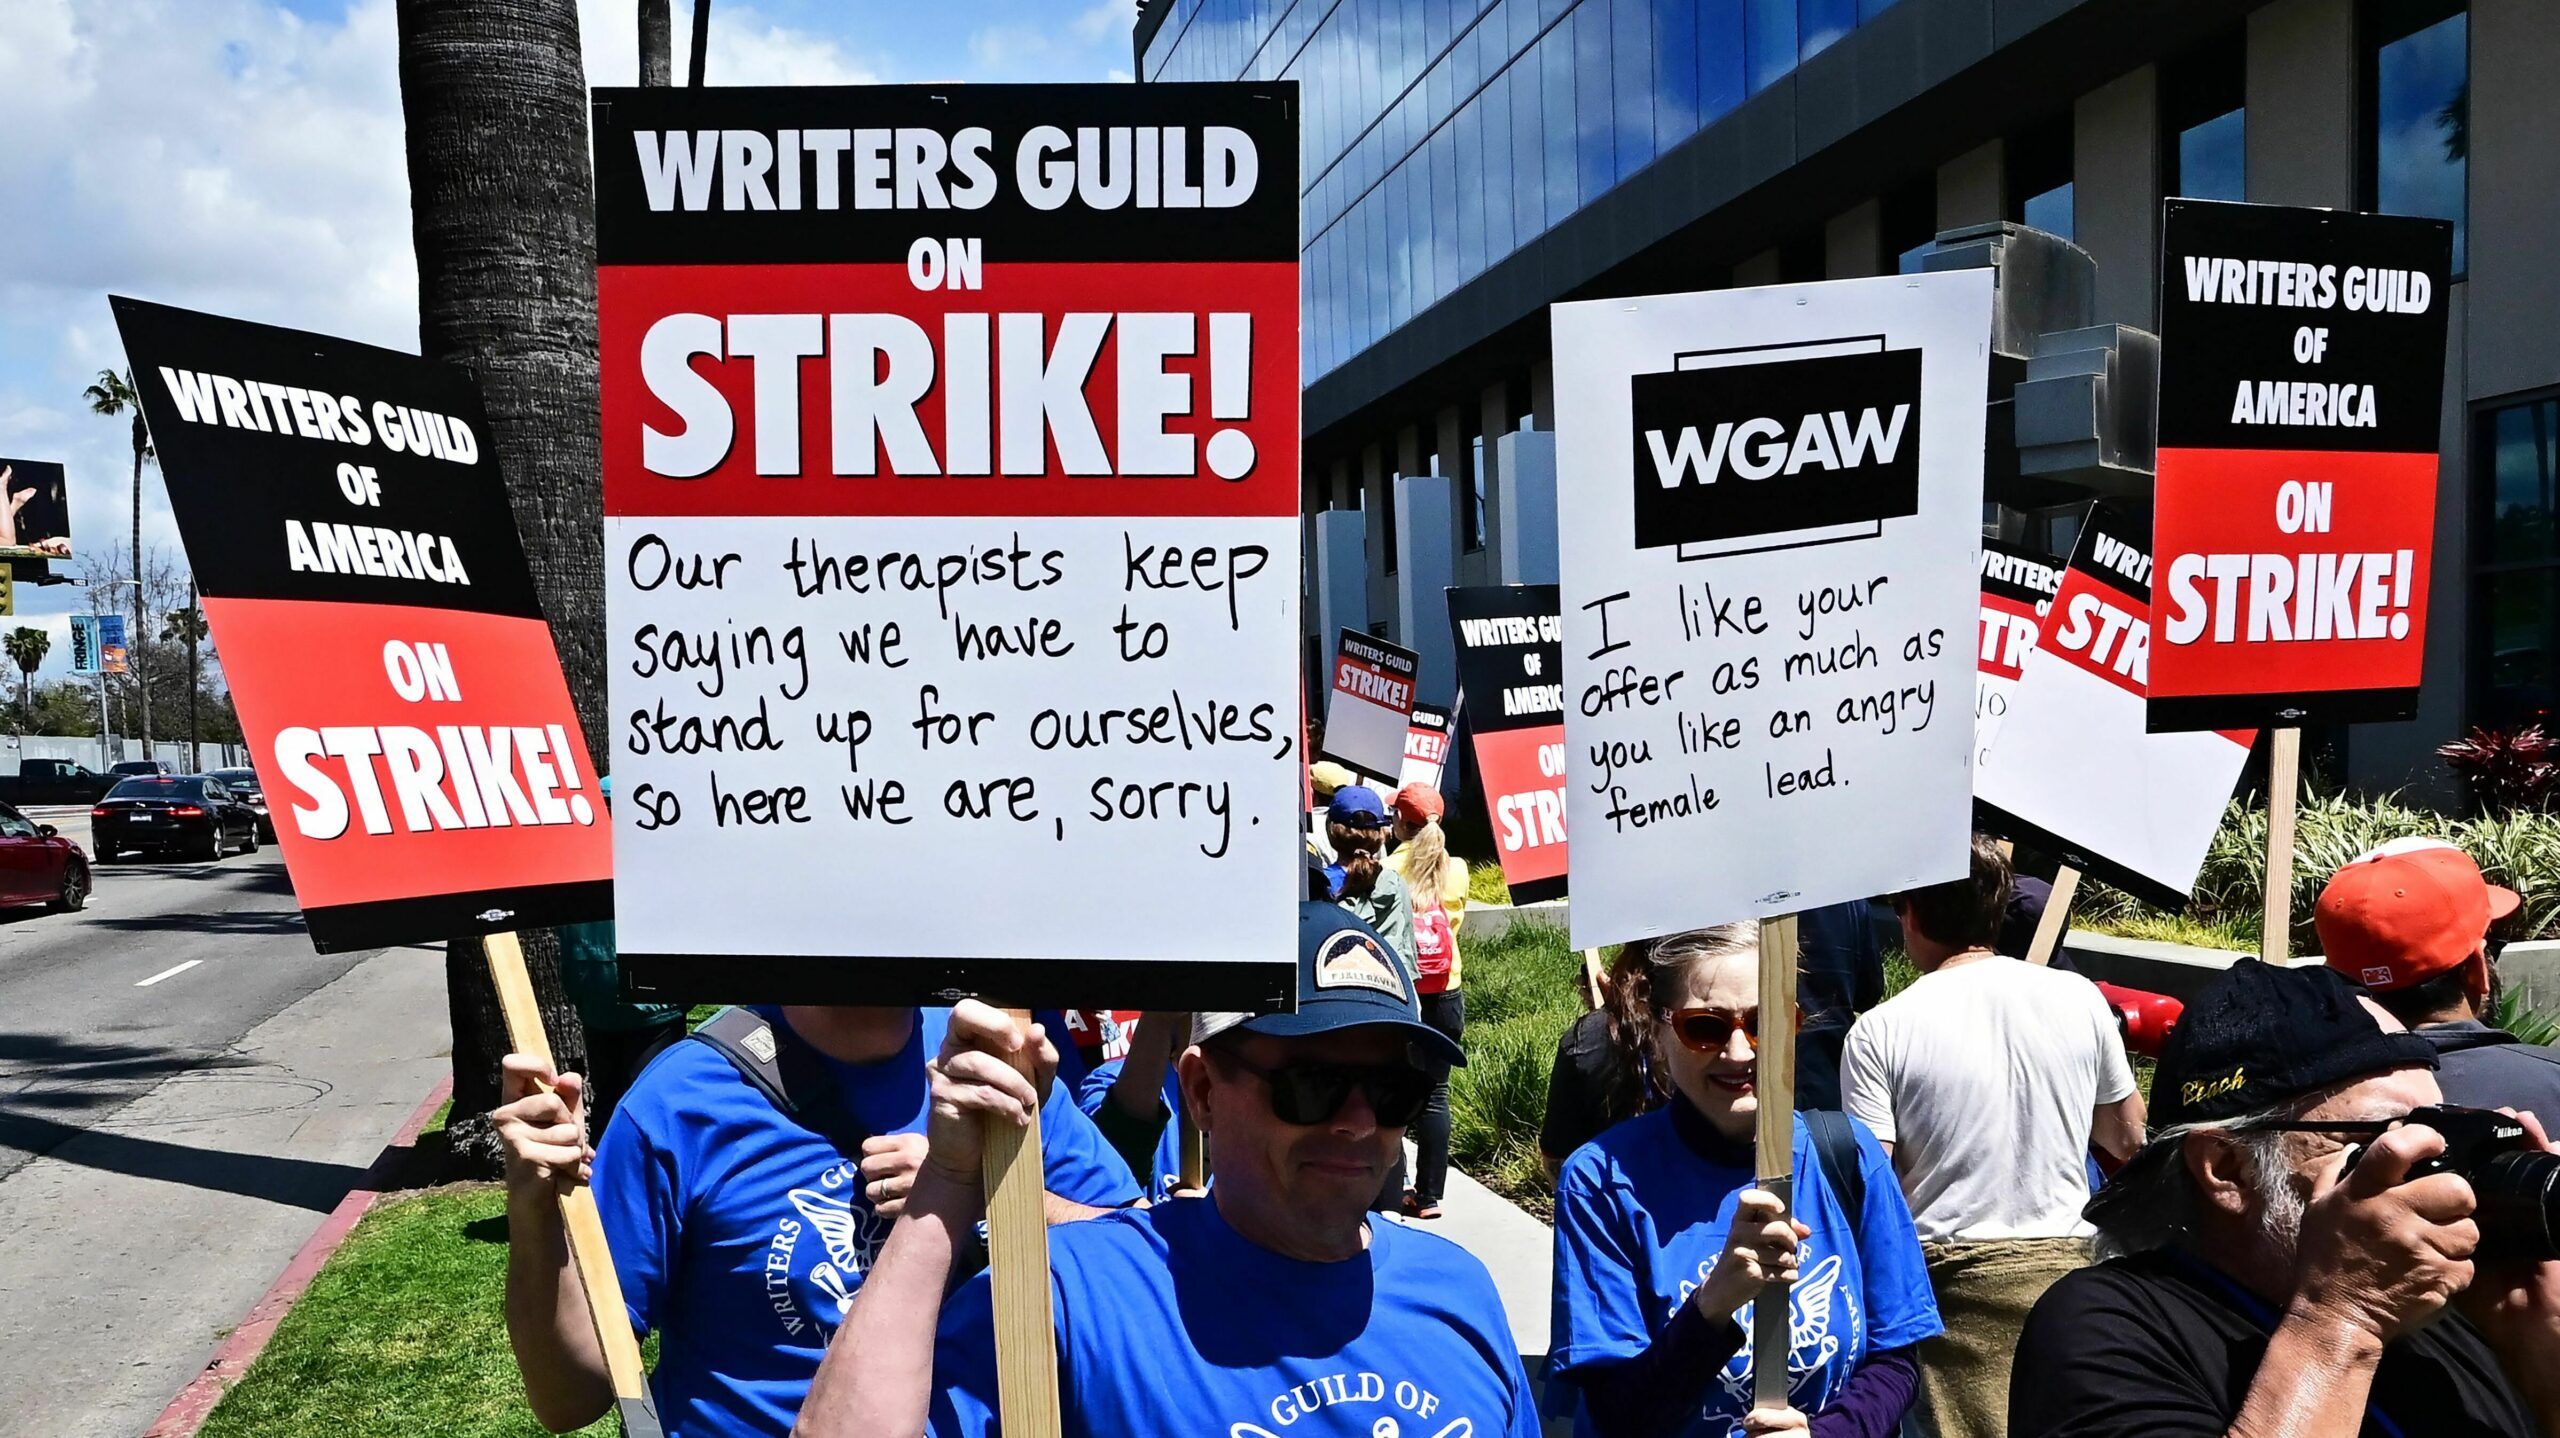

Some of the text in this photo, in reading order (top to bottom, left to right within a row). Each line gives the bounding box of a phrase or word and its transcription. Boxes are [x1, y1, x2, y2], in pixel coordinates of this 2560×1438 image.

[634, 125, 1259, 211] WRITERS GUILD
[907, 236, 982, 291] ON
[2184, 256, 2431, 315] WRITERS GUILD
[2293, 326, 2329, 364] OF
[158, 366, 478, 465] WRITERS GUILD
[640, 312, 1257, 480] STRIKE!
[2231, 380, 2377, 428] AMERICA
[1645, 403, 1910, 489] WGAW
[336, 462, 382, 507] OF
[2275, 480, 2333, 534] ON
[285, 519, 470, 585] AMERICA
[628, 530, 1269, 631] Our therapists keep
[1582, 576, 1888, 660] I like your
[2165, 549, 2414, 646] STRIKE!
[72, 623, 88, 670] FRINGE
[632, 603, 1169, 700] saying we have to
[1344, 638, 1412, 673] WRITERS GUILD
[1460, 616, 1539, 648] WRITERS
[1523, 653, 1541, 677] OF
[383, 639, 462, 702] ON
[1339, 663, 1409, 710] STRIKE!
[1580, 628, 1944, 717] offer as much as
[628, 684, 1293, 772] stand up for ourselves,
[1411, 710, 1444, 727] GUILD
[1590, 679, 1935, 794] you like an angry
[273, 724, 595, 841] STRIKE!
[632, 769, 1260, 858] so here we are, sorry.
[1605, 748, 1849, 834] female lead.
[2497, 1126, 2523, 1138] Nikon
[765, 1217, 805, 1336] WRITERS
[1271, 1372, 1440, 1426] GUILD OF
